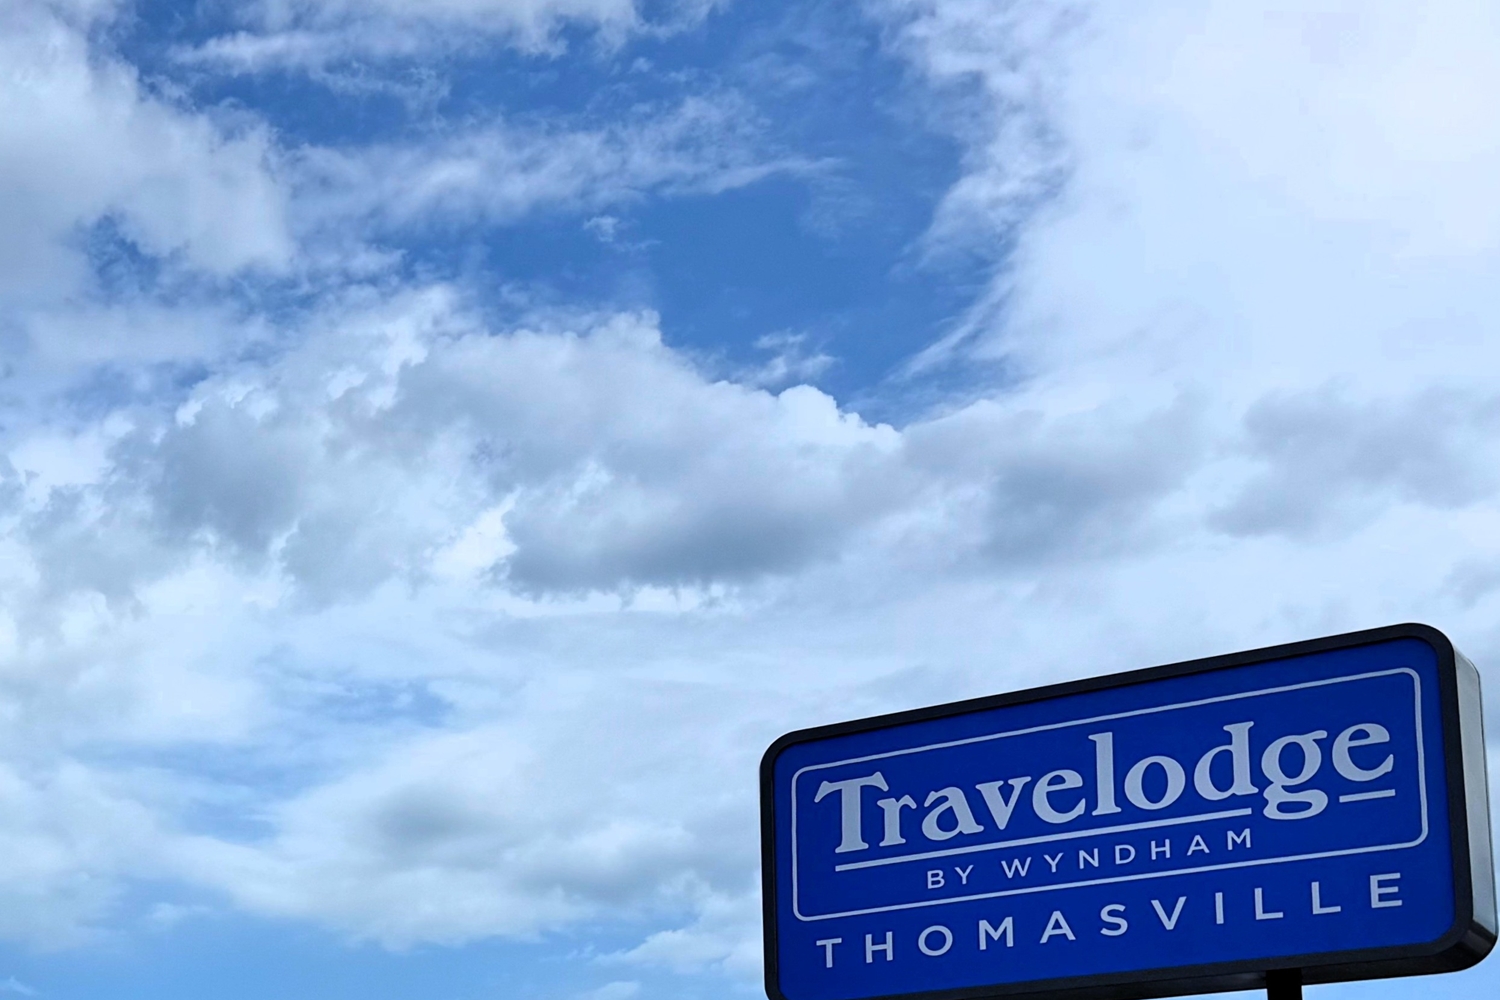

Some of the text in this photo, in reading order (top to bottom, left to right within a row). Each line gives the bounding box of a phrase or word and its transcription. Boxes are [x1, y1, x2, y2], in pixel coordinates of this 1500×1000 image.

[813, 721, 1396, 854] Travelodge
[926, 828, 1252, 890] BY WYNDHAM
[816, 872, 1402, 968] THOMASVILLE
